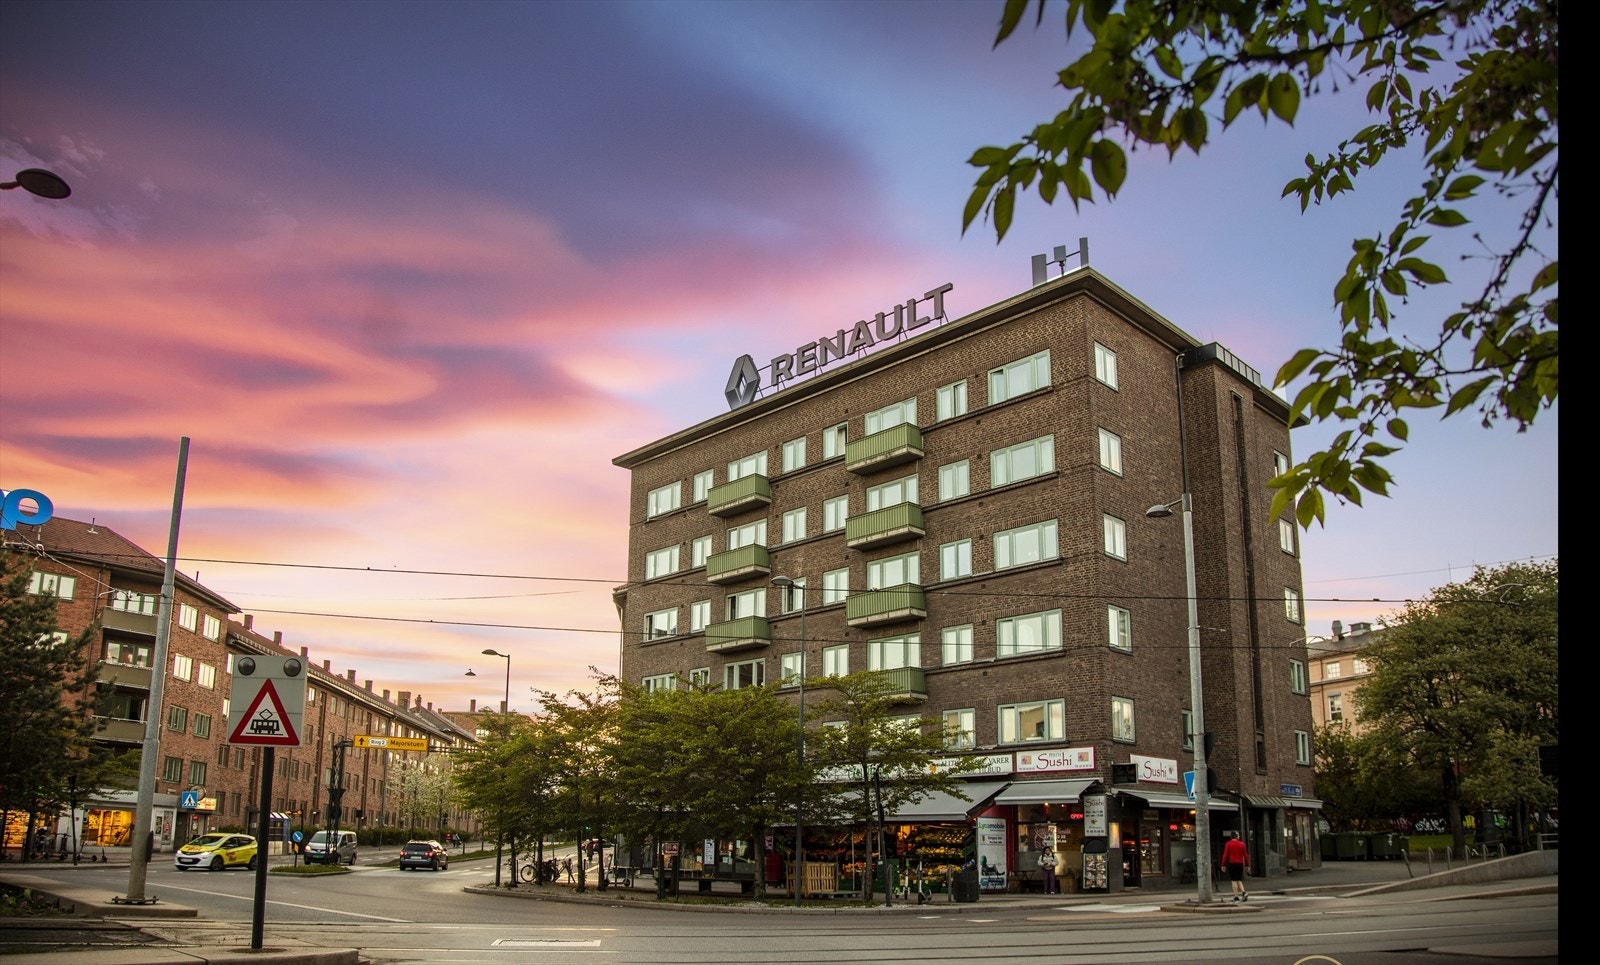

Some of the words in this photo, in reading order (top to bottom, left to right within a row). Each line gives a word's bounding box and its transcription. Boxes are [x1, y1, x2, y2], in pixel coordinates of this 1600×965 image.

[770, 282, 954, 386] RENAULT
[0, 488, 53, 531] p
[1036, 752, 1072, 769] Sushi
[1143, 760, 1167, 779] Sushi
[979, 822, 1005, 830] Lycamobile
